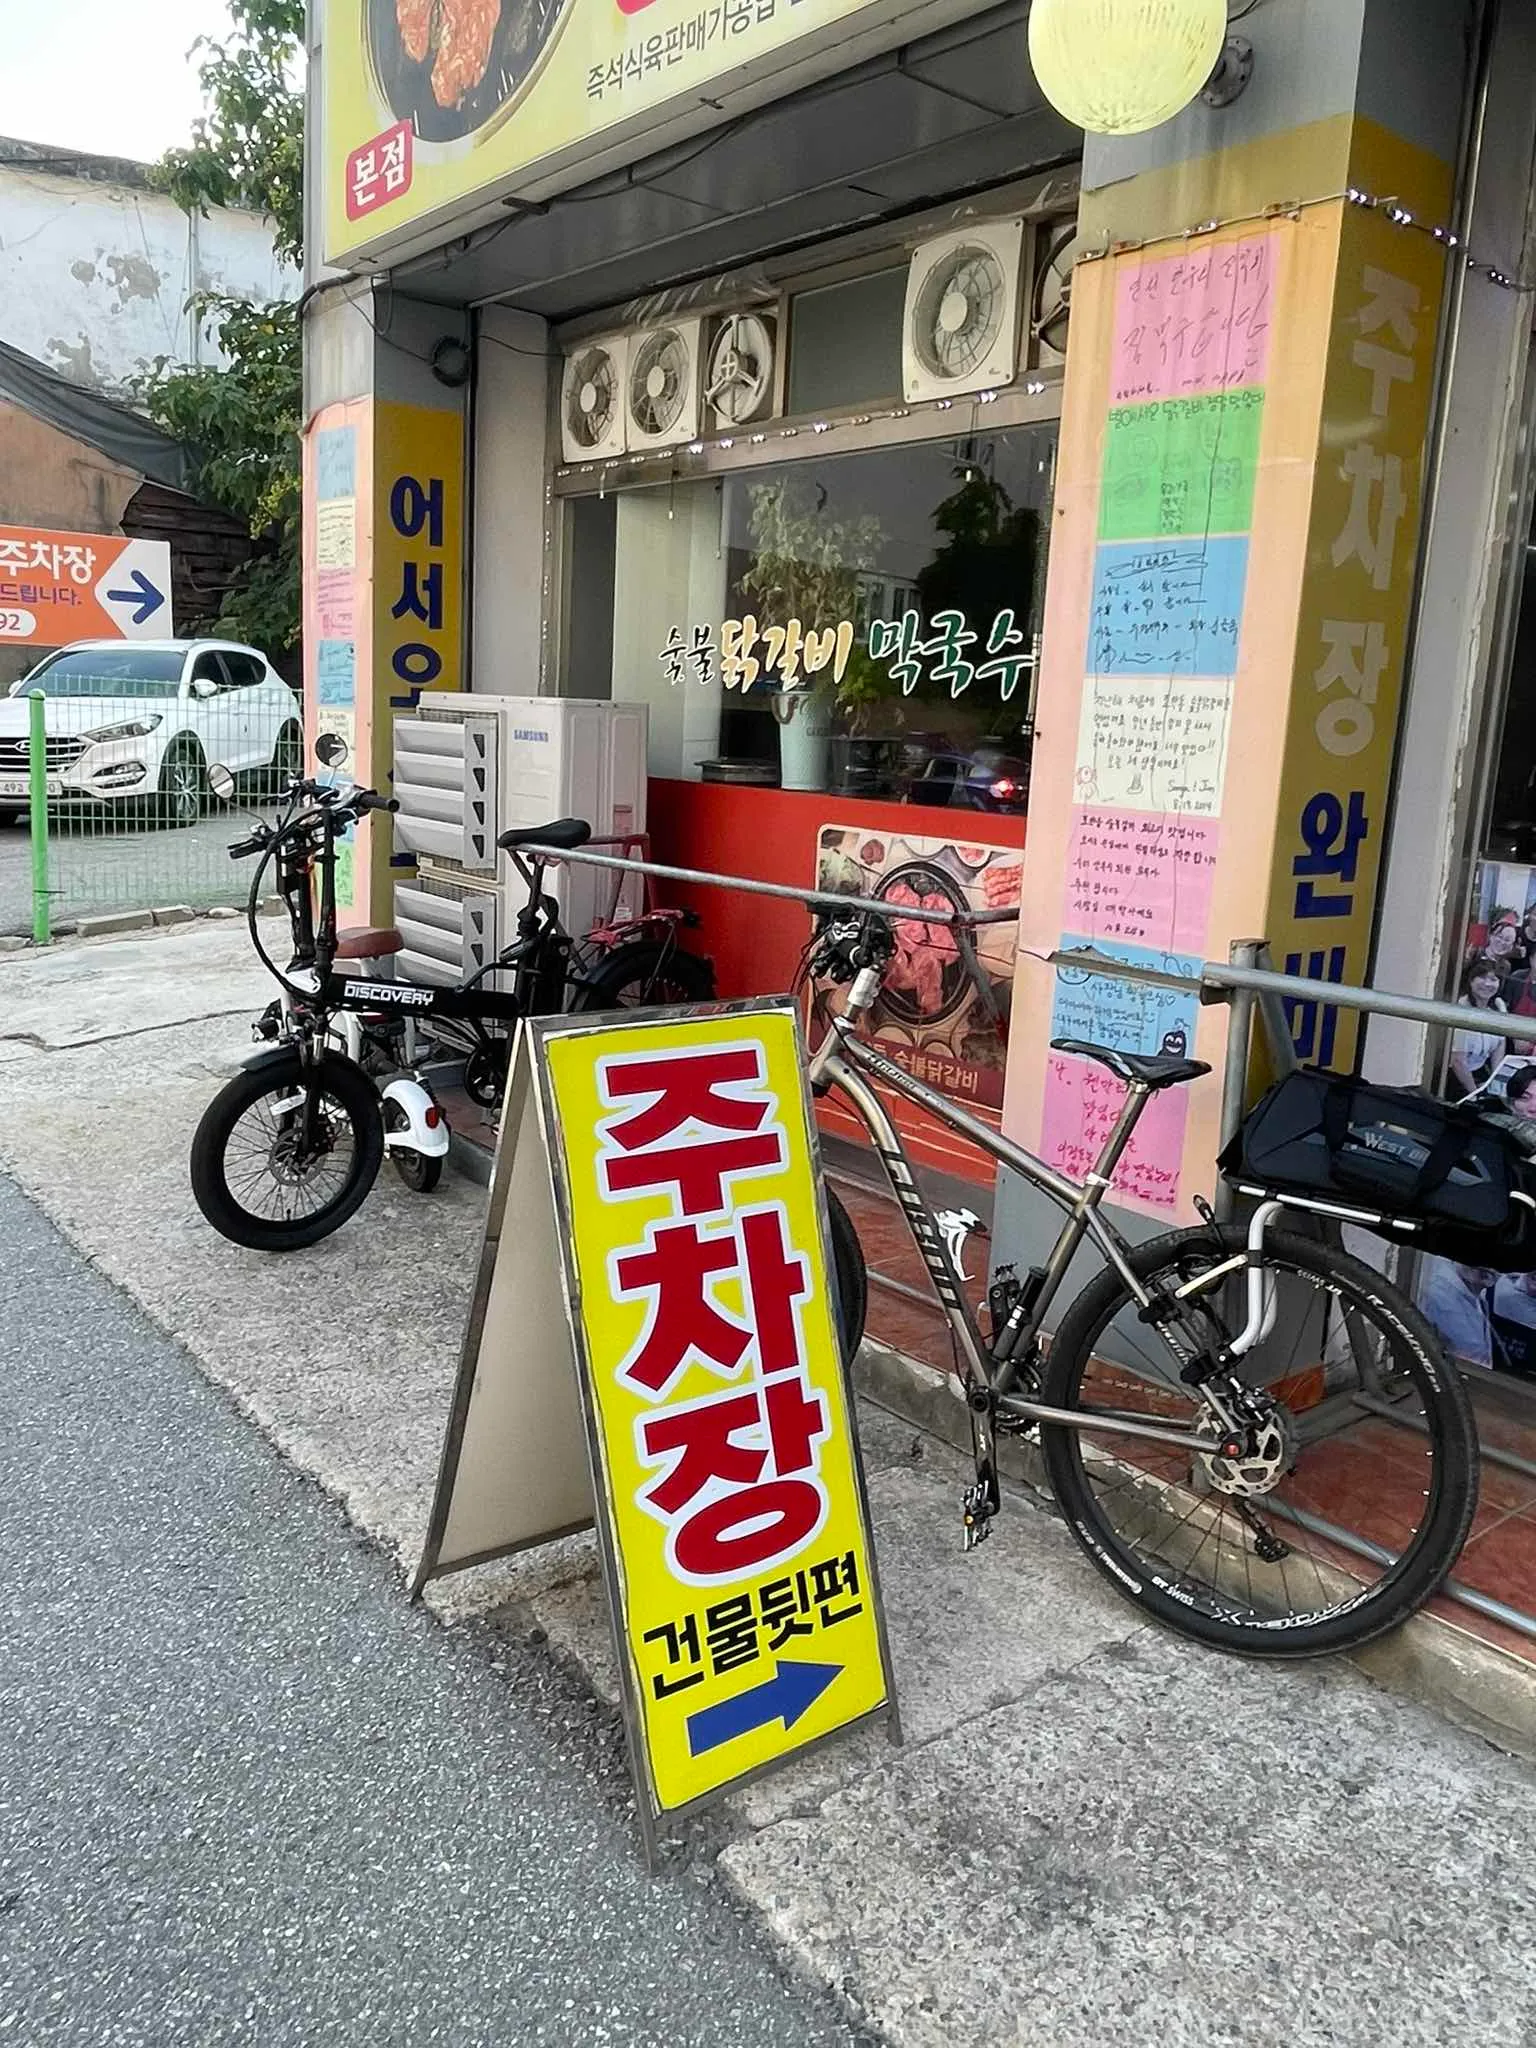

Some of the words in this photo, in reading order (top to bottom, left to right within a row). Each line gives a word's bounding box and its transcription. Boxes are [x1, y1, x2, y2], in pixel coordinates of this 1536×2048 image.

[352, 130, 406, 207] 본점
[1314, 263, 1421, 758] 주차장
[0, 540, 97, 584] 주차장
[0, 583, 82, 606] 드립니다.
[868, 608, 1040, 701] 막국수
[513, 728, 549, 743] SAMSUNG
[1281, 791, 1368, 1067] 완비
[343, 981, 435, 1007] DISCOVERY
[603, 1046, 824, 1578] 주차장
[643, 1550, 864, 1700] 건물뒷편
